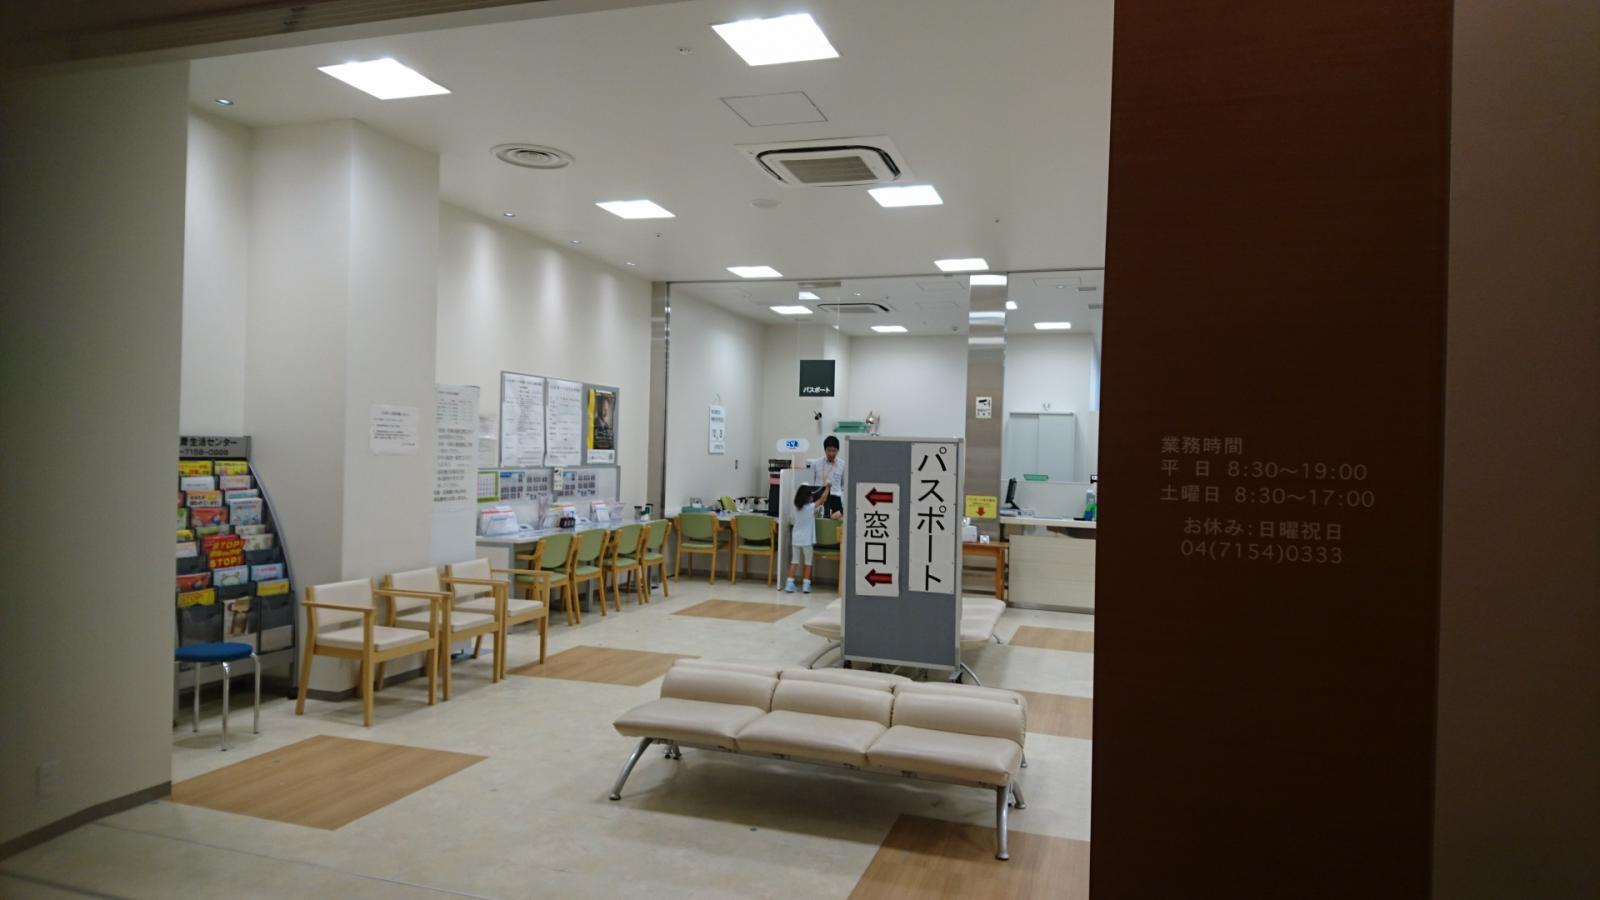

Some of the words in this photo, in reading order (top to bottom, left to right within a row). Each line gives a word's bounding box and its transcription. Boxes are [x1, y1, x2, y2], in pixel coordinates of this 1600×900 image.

[803, 386, 831, 394] パスポート
[1160, 436, 1243, 455] 業務時間
[1160, 485, 1220, 503] 土曜日
[917, 446, 948, 591] パスポート
[863, 510, 890, 566] 窓口
[1181, 540, 1343, 565] 04(7154)0333
